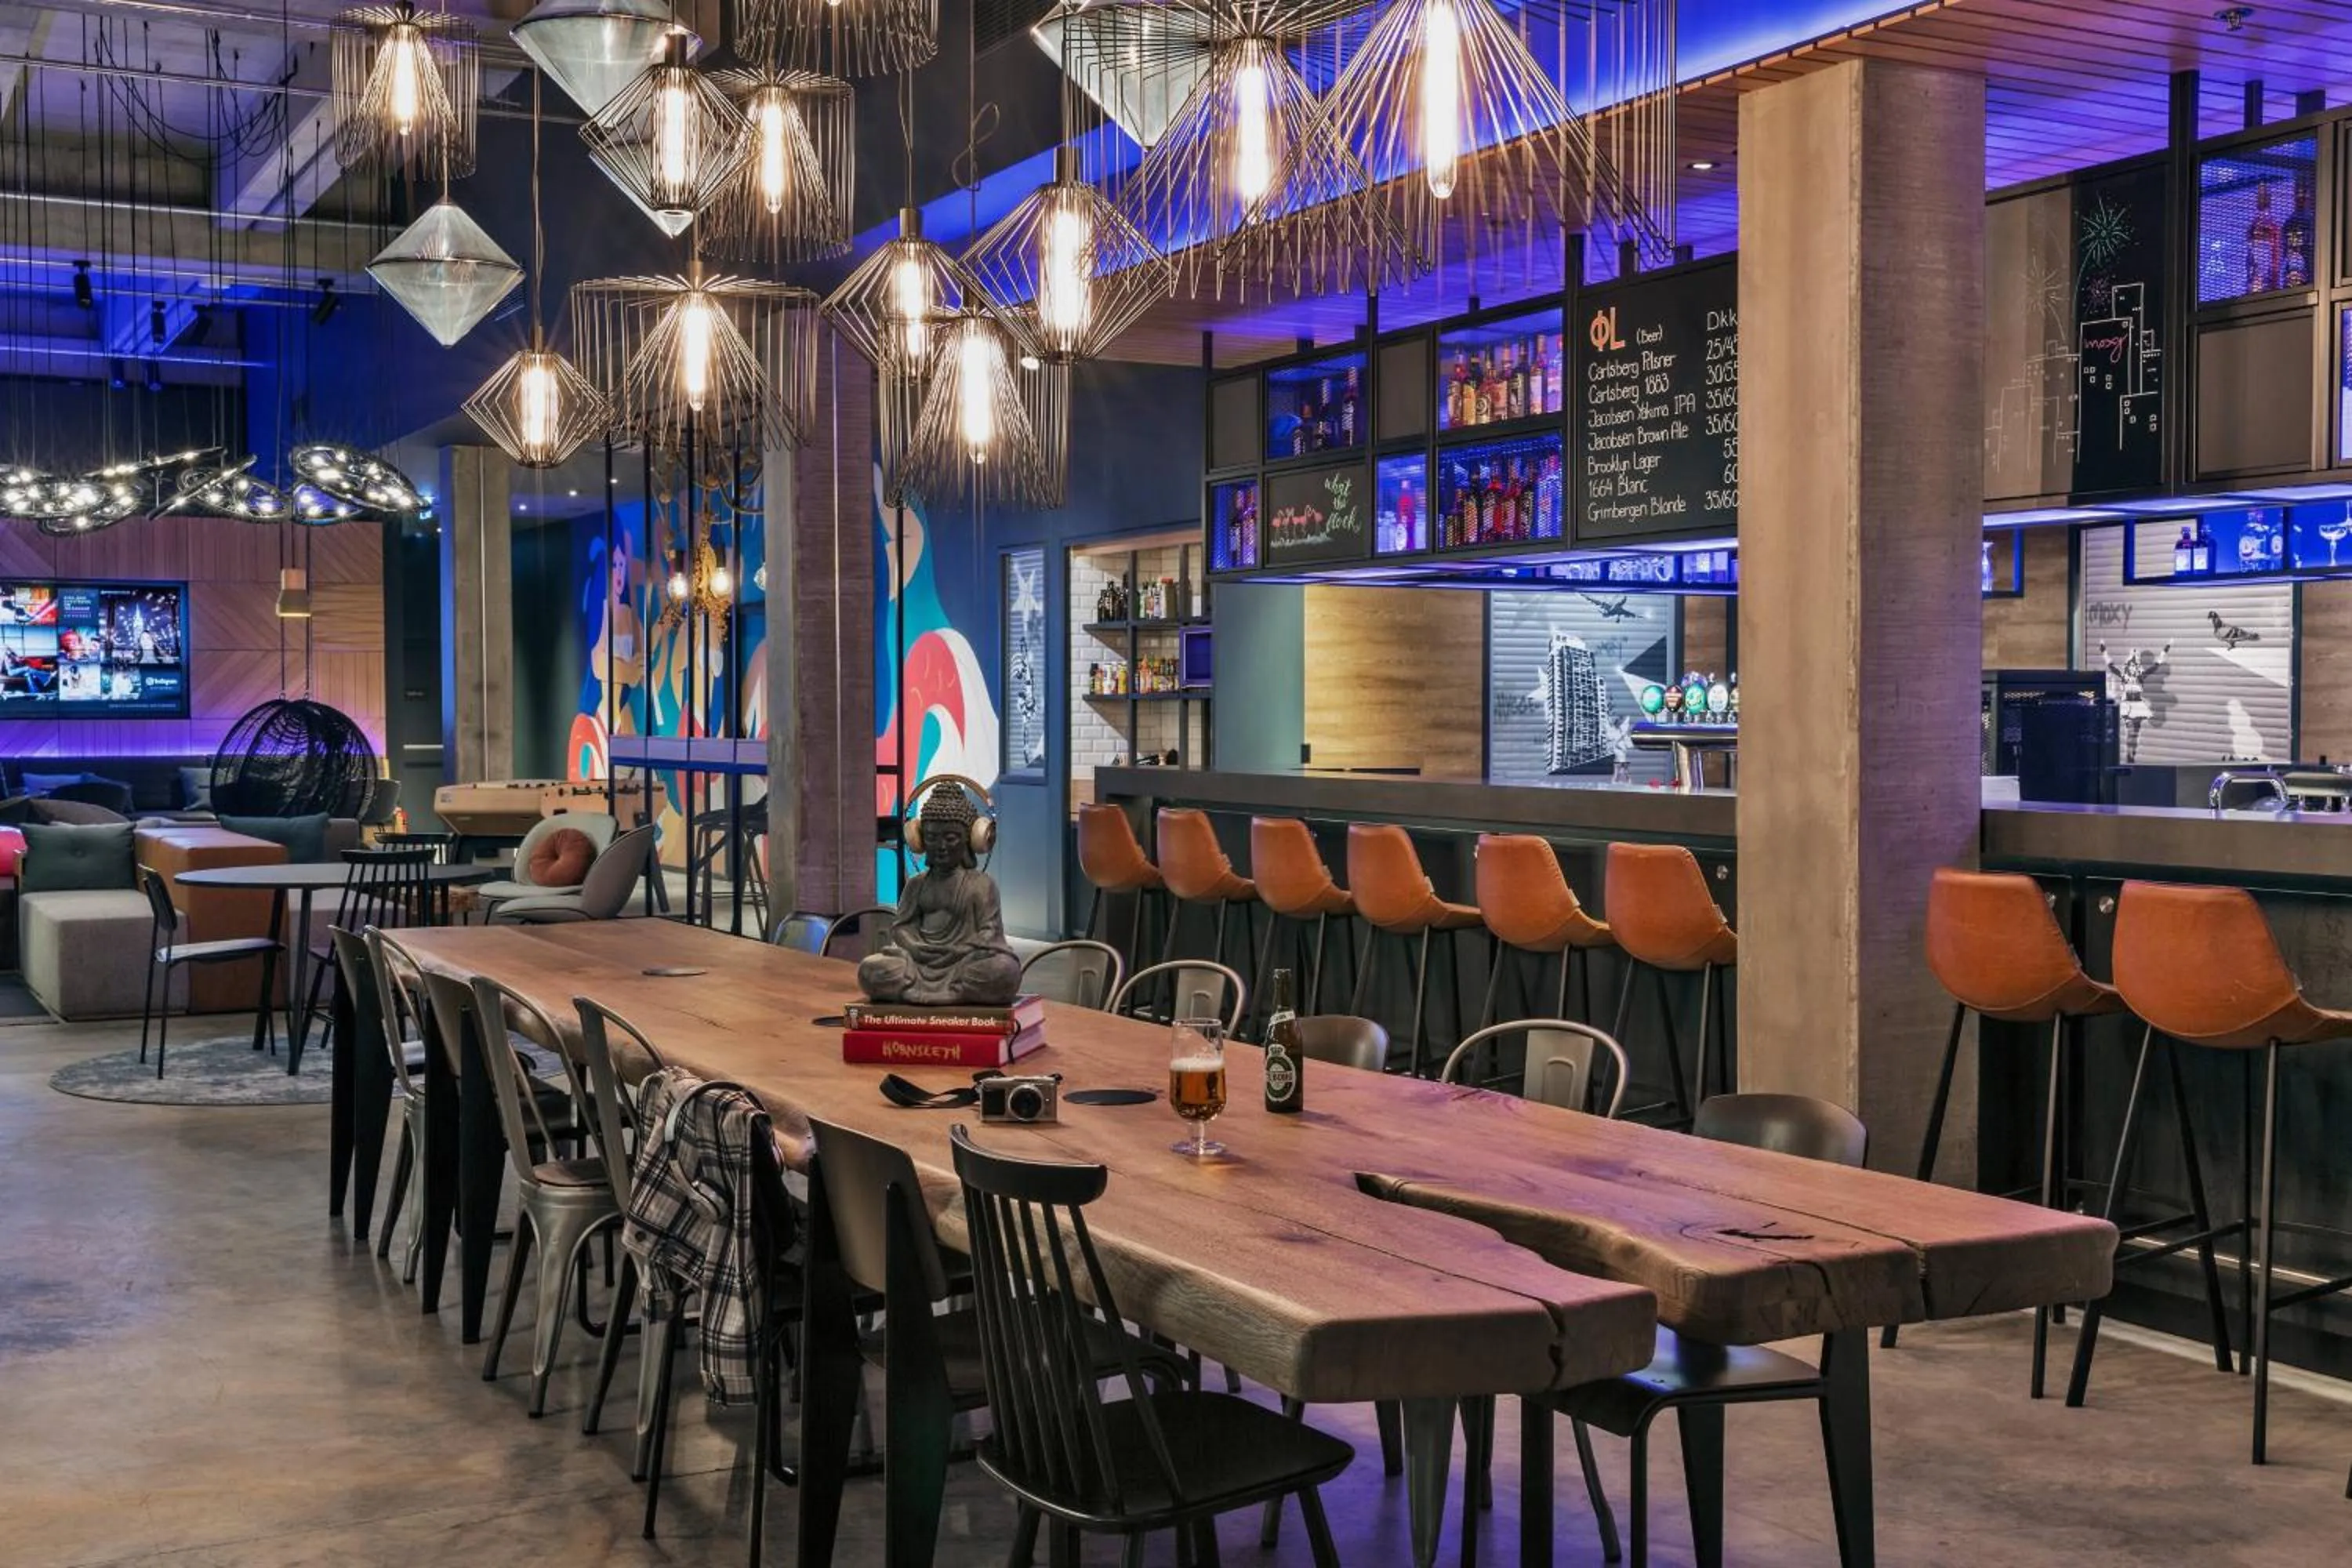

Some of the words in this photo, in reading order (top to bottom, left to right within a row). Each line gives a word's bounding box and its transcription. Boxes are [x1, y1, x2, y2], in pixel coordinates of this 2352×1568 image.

[1588, 359, 1639, 382] Carlsberg
[1642, 350, 1677, 371] Pilsner
[1588, 383, 1639, 404] Carlsberg
[1645, 373, 1669, 394] 1883
[1588, 407, 1635, 427] Jacobsen
[1674, 393, 1696, 415] IPA
[1588, 431, 1635, 451] Jacobsen
[1638, 426, 1669, 445] Brown
[1671, 421, 1689, 439] Ale
[1588, 452, 1630, 476] Brooklyn
[1633, 452, 1661, 474] Lager
[1589, 479, 1612, 499] 1664
[1617, 475, 1649, 496] Blanc
[1588, 502, 1646, 522] Grimbergen
[1650, 494, 1686, 516] Blonde
[864, 1015, 882, 1025] The
[884, 1015, 927, 1025] Ultimate
[929, 1016, 969, 1026] Sneaker
[971, 1017, 996, 1027] Book
